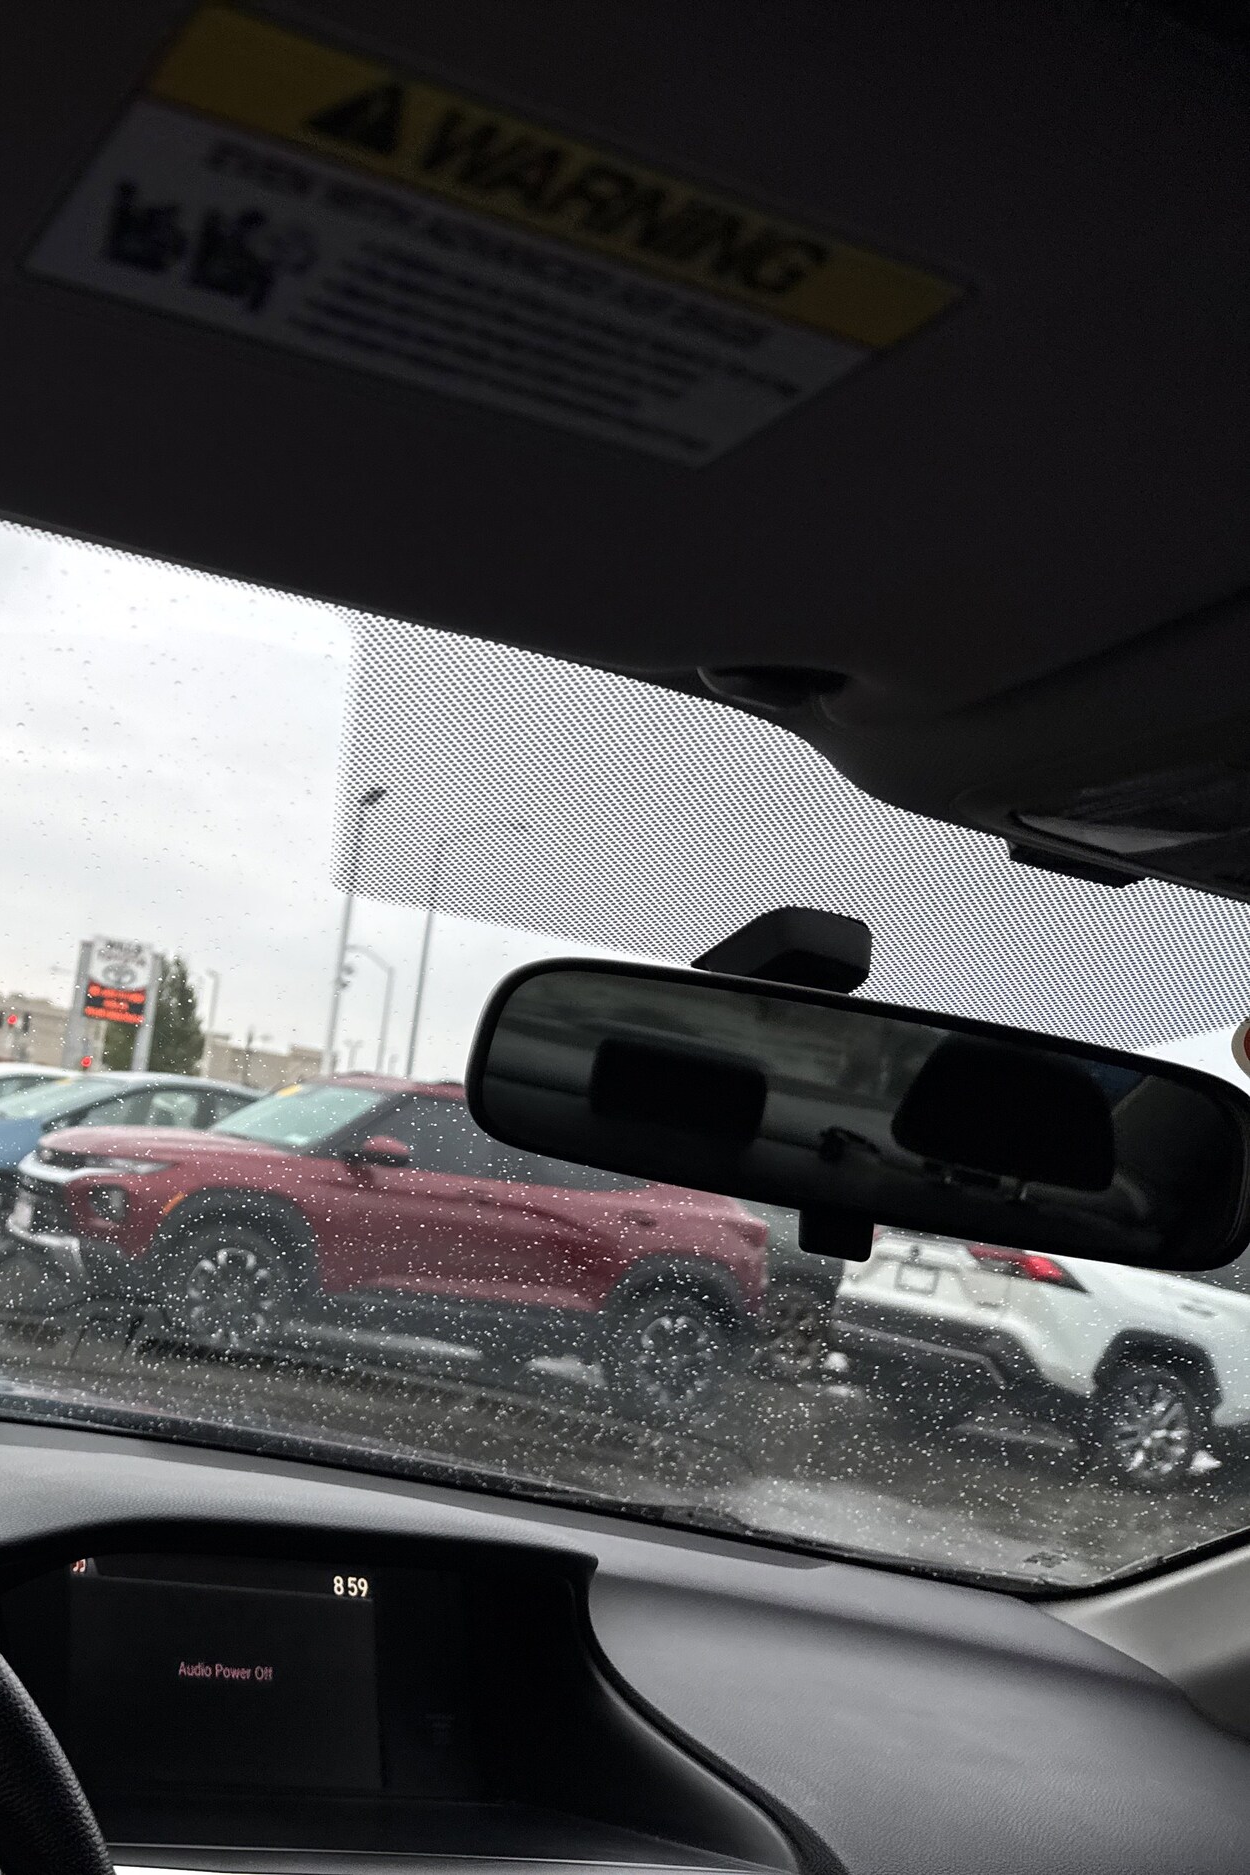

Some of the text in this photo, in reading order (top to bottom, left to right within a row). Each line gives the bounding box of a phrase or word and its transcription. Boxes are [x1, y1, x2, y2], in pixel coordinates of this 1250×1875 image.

[422, 108, 828, 294] WARNING
[178, 1661, 274, 1681] Audio Power Off
